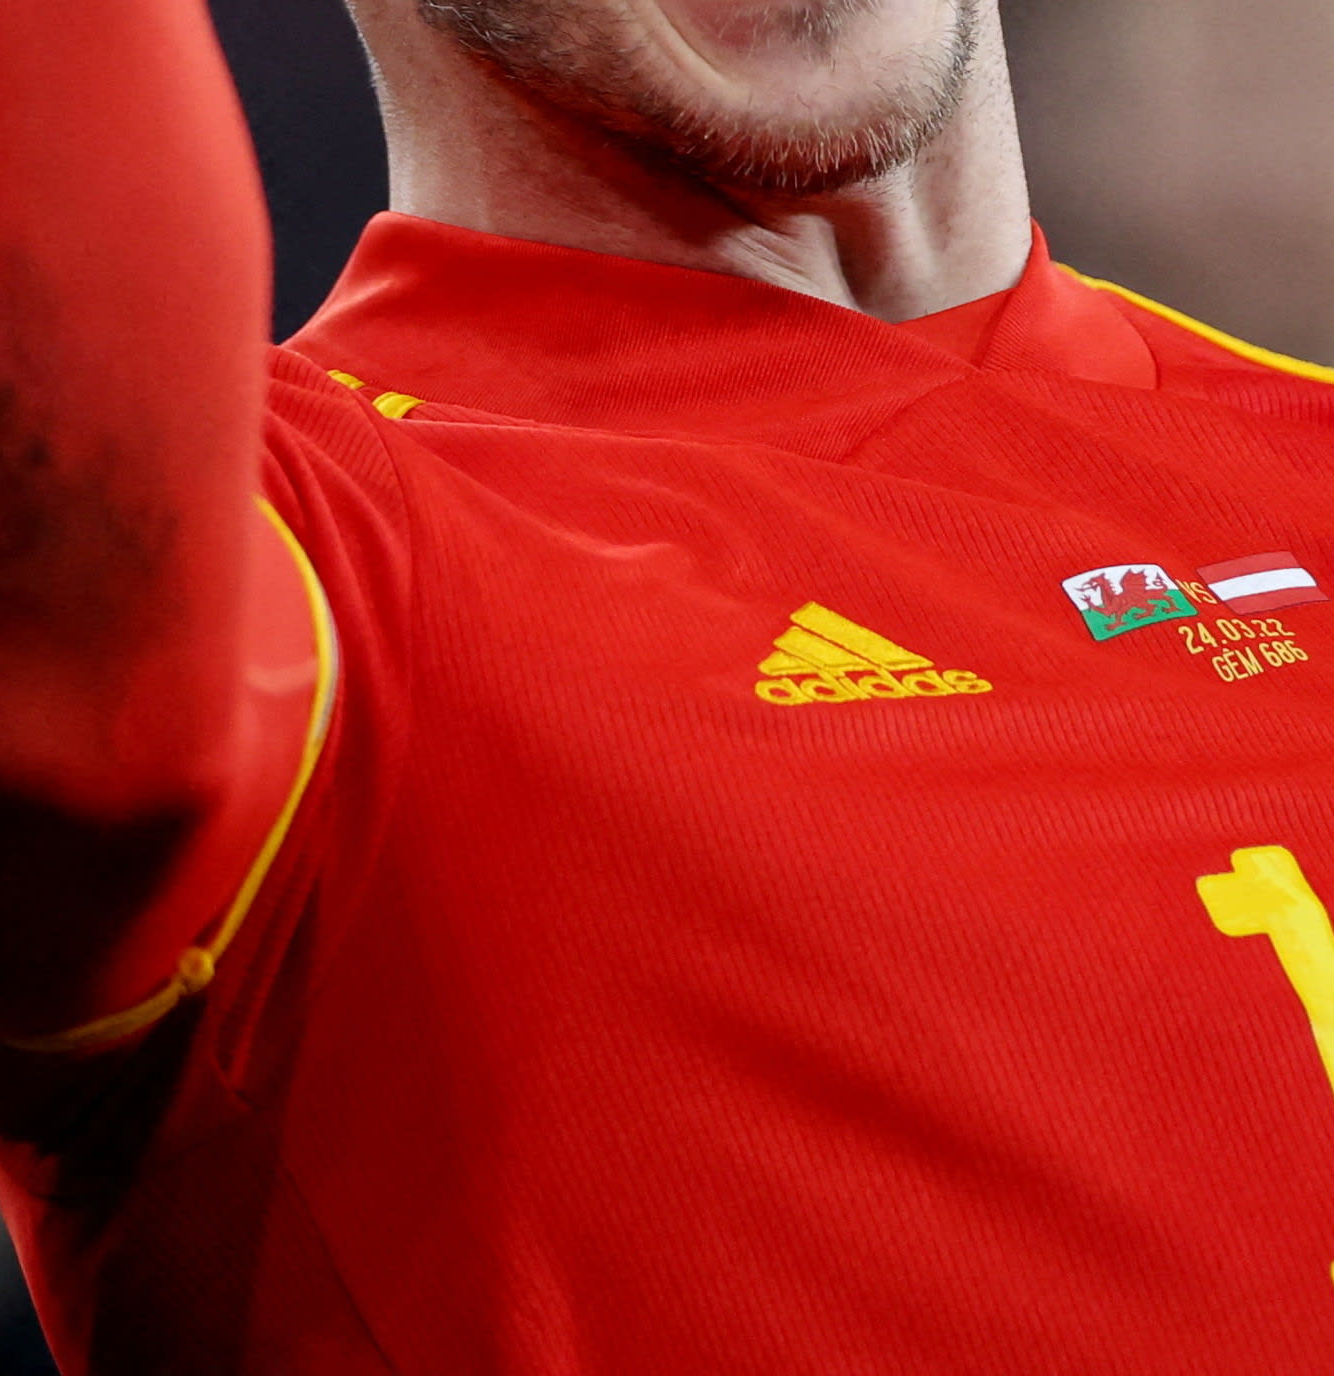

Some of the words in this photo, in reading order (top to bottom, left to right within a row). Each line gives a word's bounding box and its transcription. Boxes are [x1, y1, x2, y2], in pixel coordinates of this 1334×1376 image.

[1175, 579, 1218, 604] VS
[1178, 618, 1295, 654] 24.03.22
[1259, 640, 1308, 667] 686
[755, 669, 993, 705] adidas
